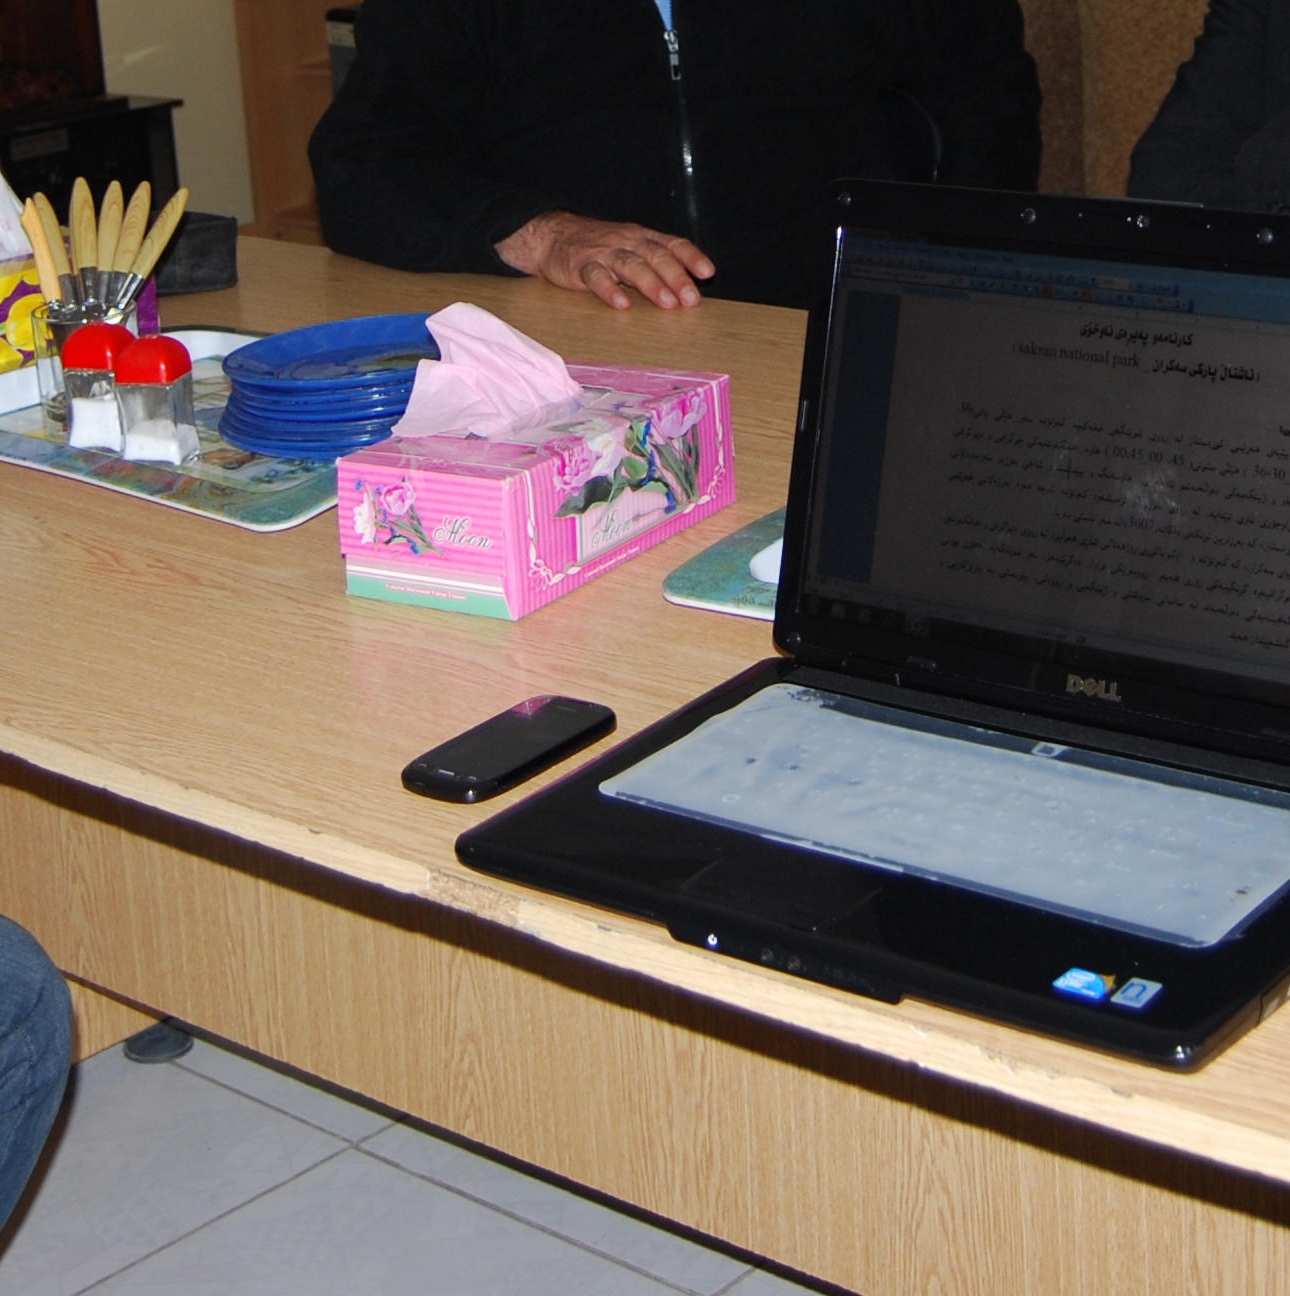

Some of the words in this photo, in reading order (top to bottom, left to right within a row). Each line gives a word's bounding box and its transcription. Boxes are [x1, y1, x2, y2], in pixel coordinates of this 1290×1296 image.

[1060, 349, 1109, 364] national
[1112, 354, 1139, 368] park
[1066, 673, 1122, 702] DELL
